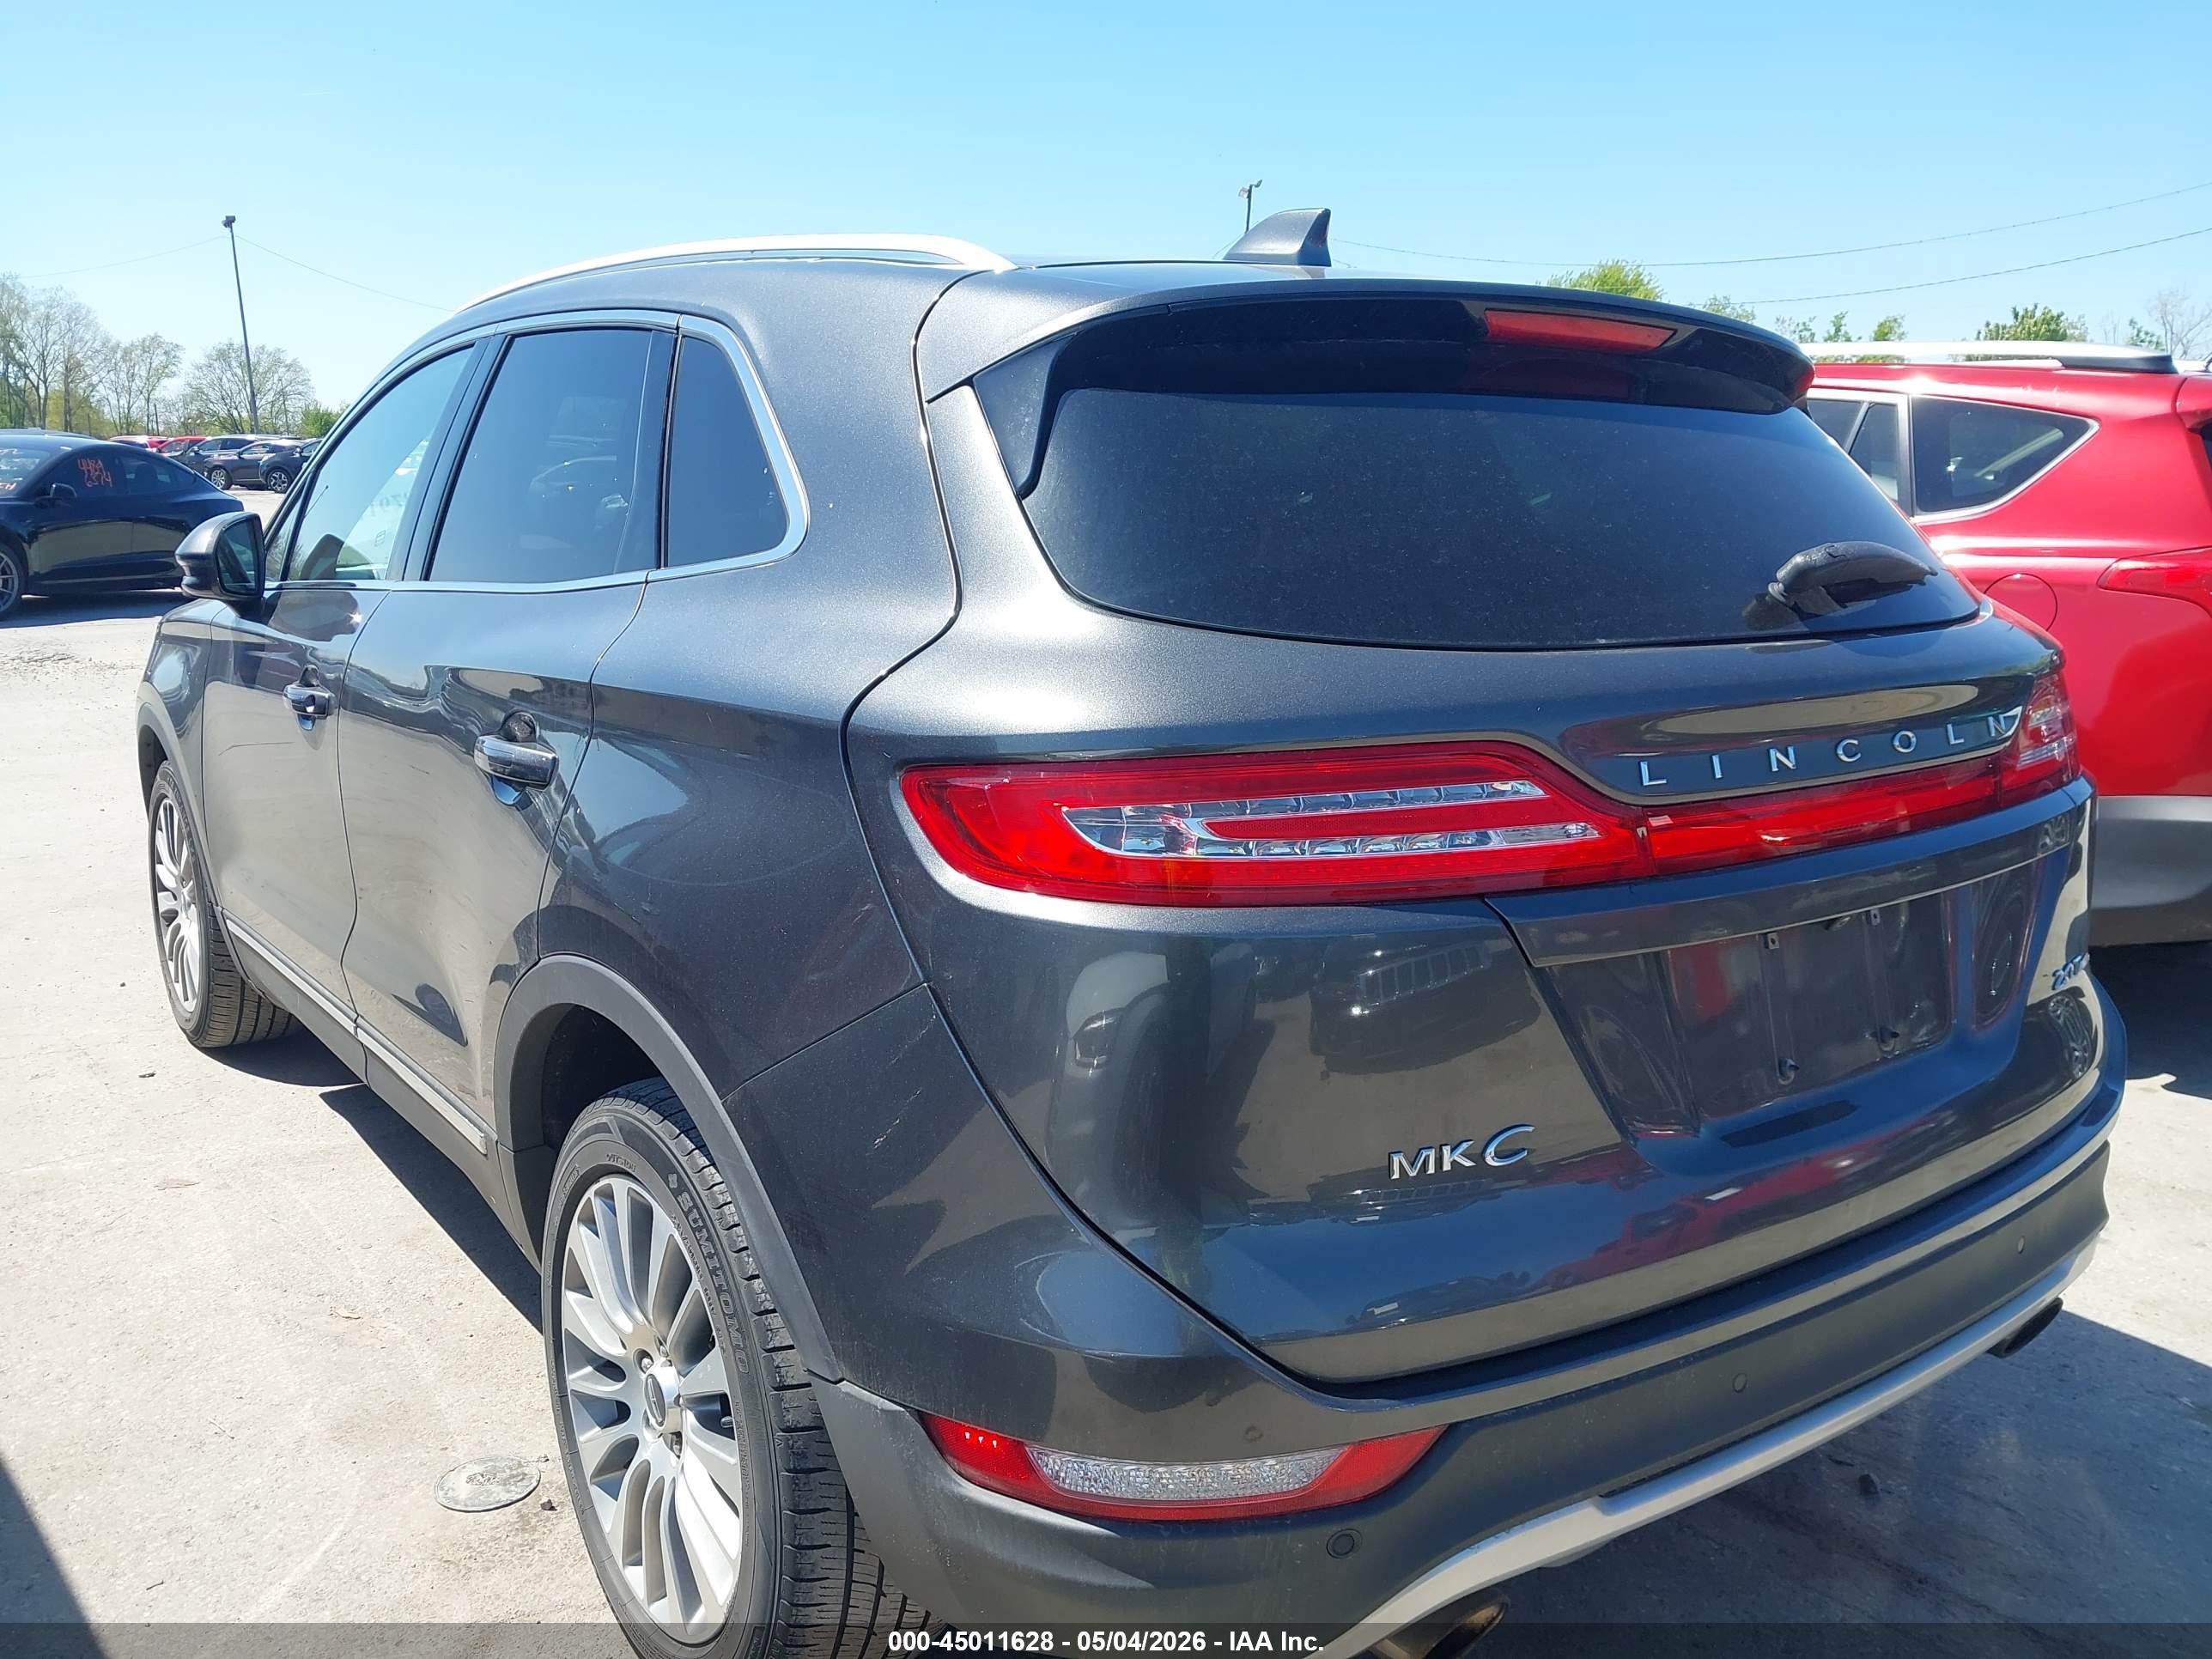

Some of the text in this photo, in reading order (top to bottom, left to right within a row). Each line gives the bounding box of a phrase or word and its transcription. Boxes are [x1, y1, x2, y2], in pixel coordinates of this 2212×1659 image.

[1638, 714, 2007, 787] LINCOLN
[1388, 1123, 1535, 1180] MKC
[675, 1190, 750, 1374] SUMITOMO
